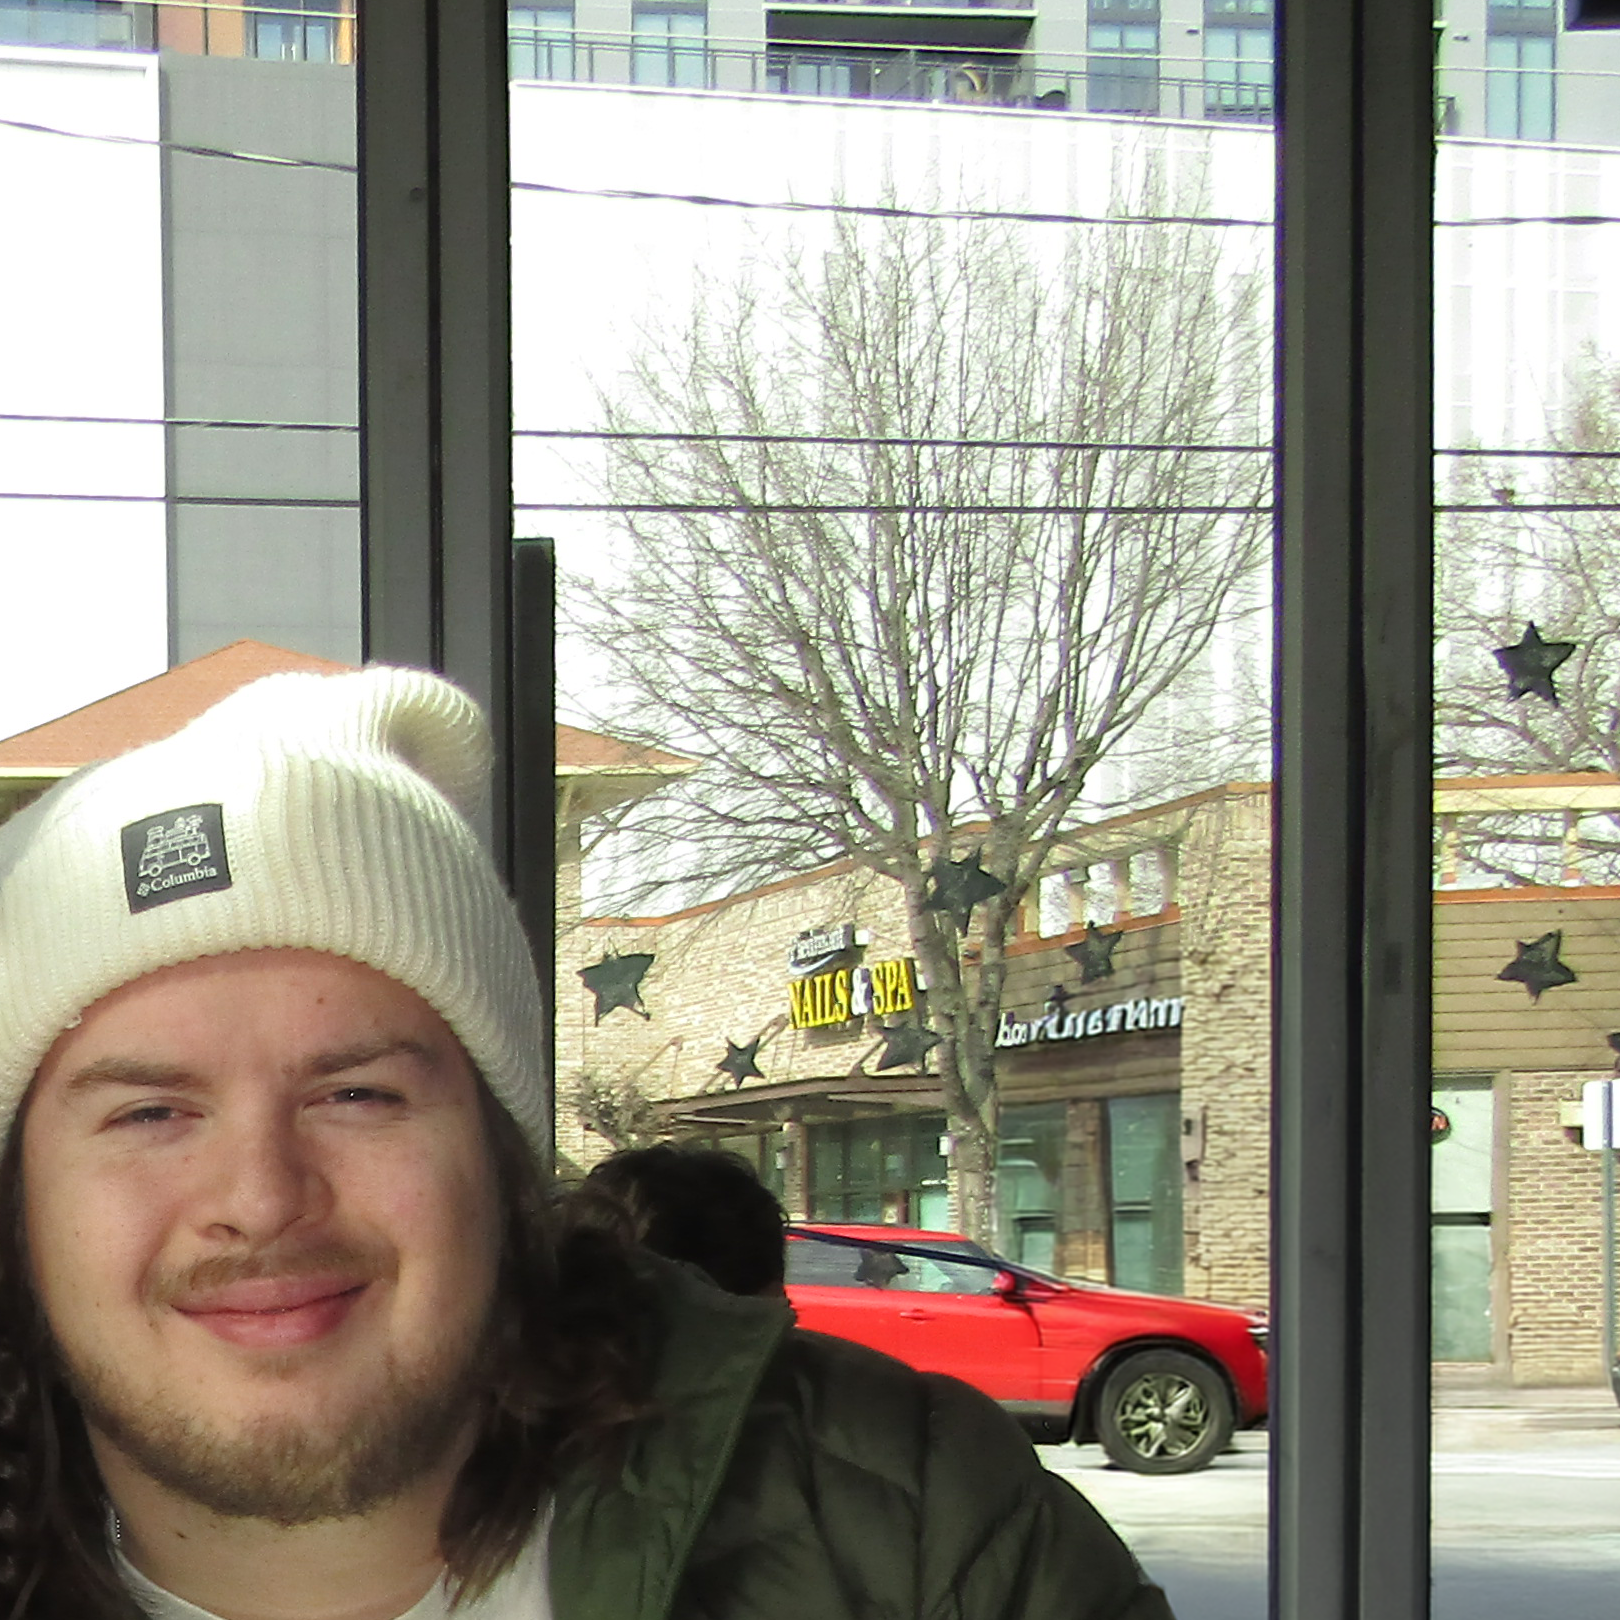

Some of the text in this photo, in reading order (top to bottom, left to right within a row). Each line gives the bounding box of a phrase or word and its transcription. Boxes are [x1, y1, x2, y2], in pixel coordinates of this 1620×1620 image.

[150, 866, 218, 892] Columbia
[787, 958, 914, 1030] NAILS & SPA
